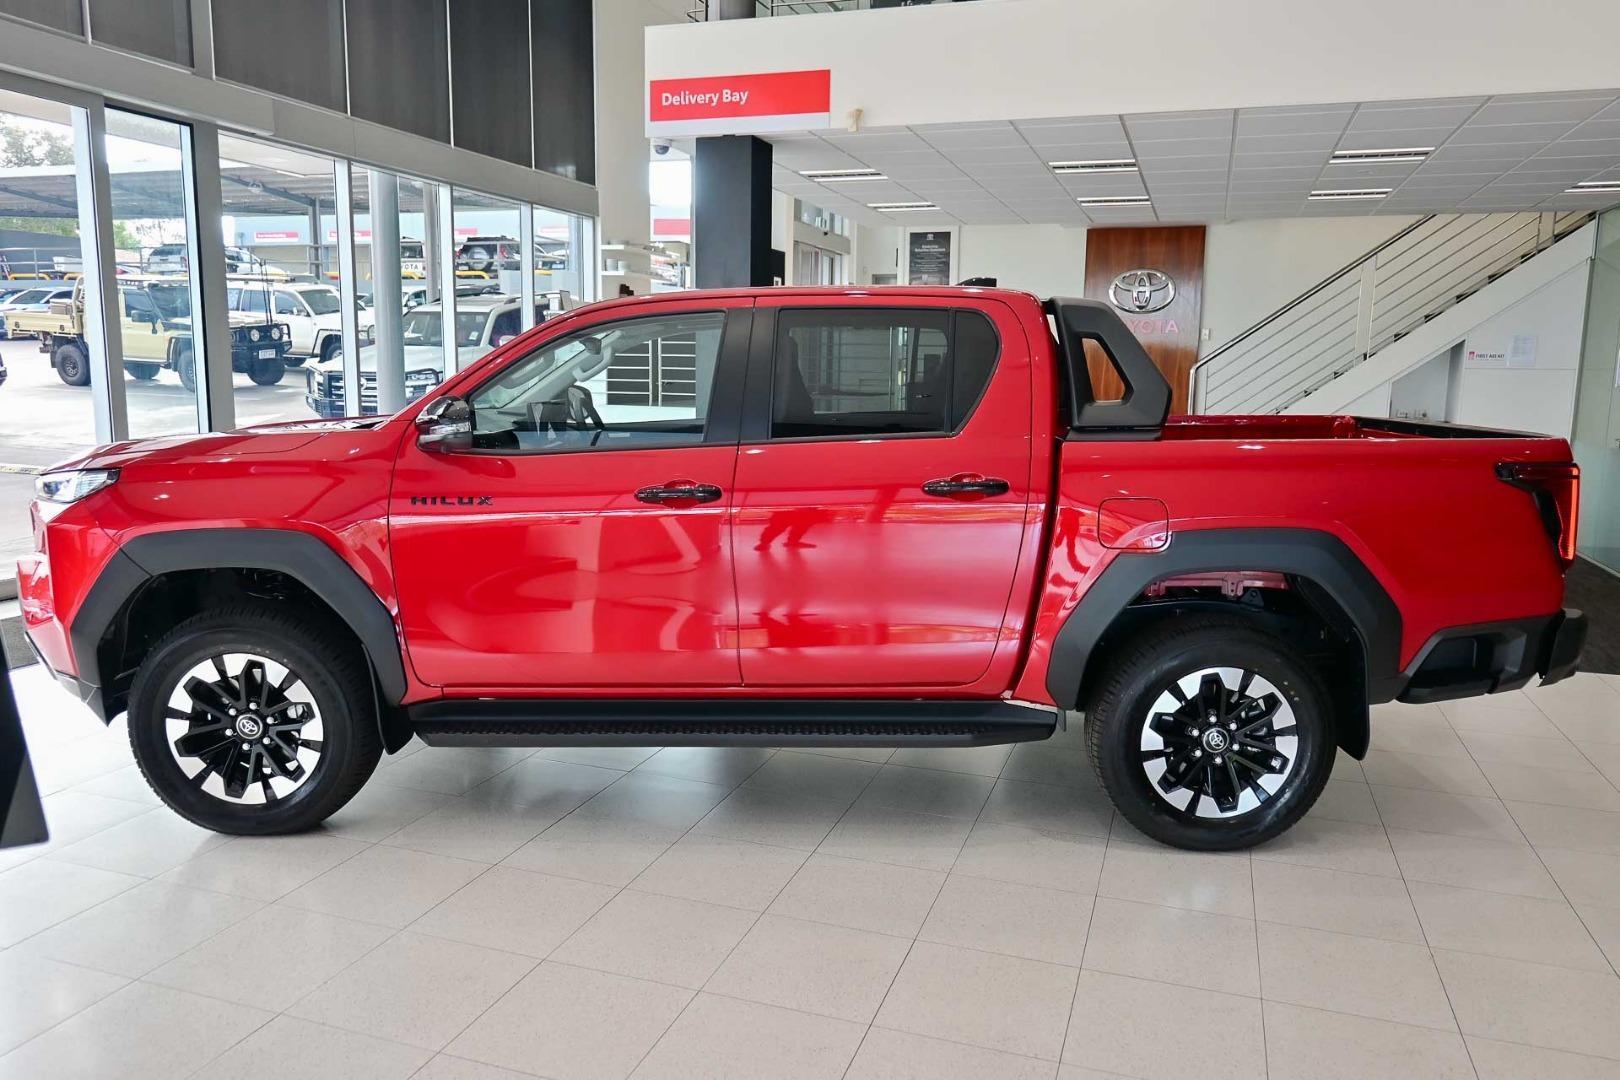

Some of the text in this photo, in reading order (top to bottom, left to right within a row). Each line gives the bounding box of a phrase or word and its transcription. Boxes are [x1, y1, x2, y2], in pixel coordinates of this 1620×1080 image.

[661, 89, 748, 106] Delivery Bay
[1129, 319, 1179, 335] YOTA
[411, 496, 493, 505] HILUX
